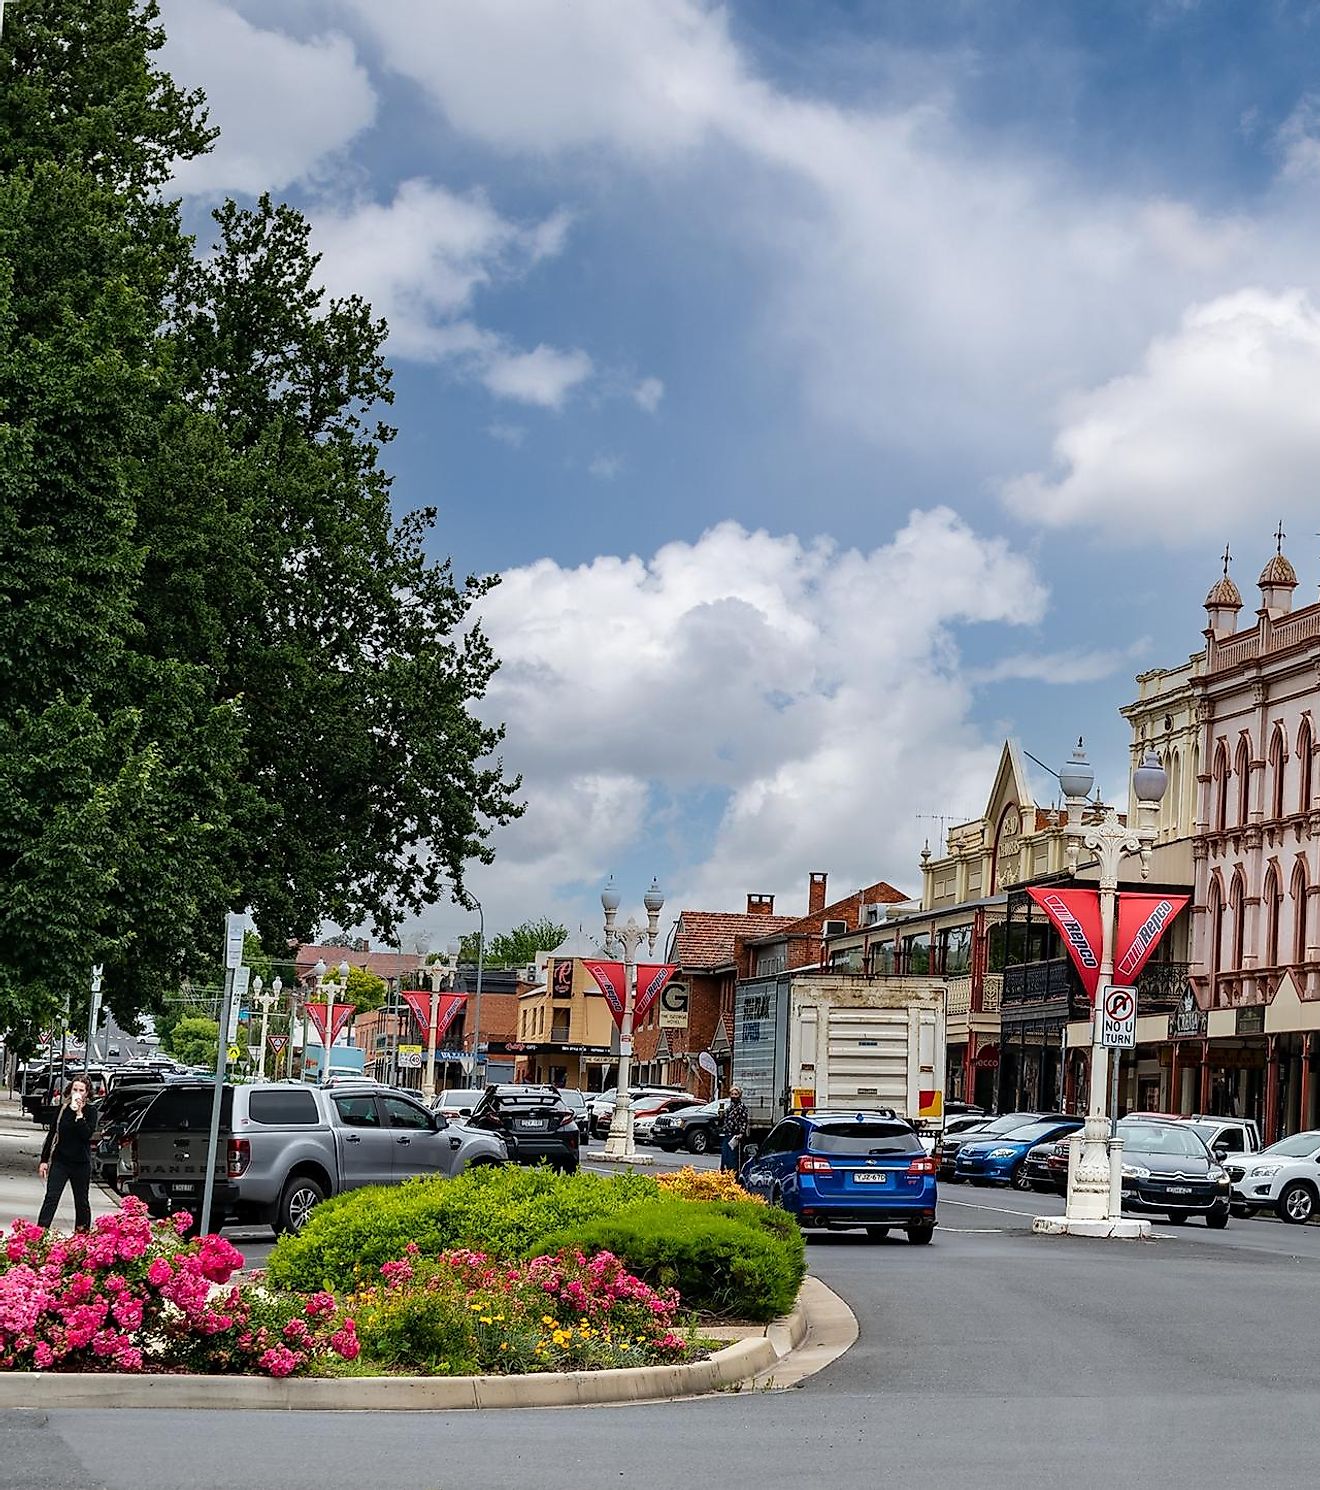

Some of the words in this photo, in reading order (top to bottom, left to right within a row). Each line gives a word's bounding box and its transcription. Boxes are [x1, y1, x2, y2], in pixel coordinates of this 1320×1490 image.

[1139, 900, 1174, 948] Repco
[1063, 918, 1099, 969] Repco
[661, 983, 689, 1012] G
[1105, 1020, 1122, 1032] NO
[1125, 1021, 1133, 1033] U
[1105, 1033, 1131, 1045] TURN
